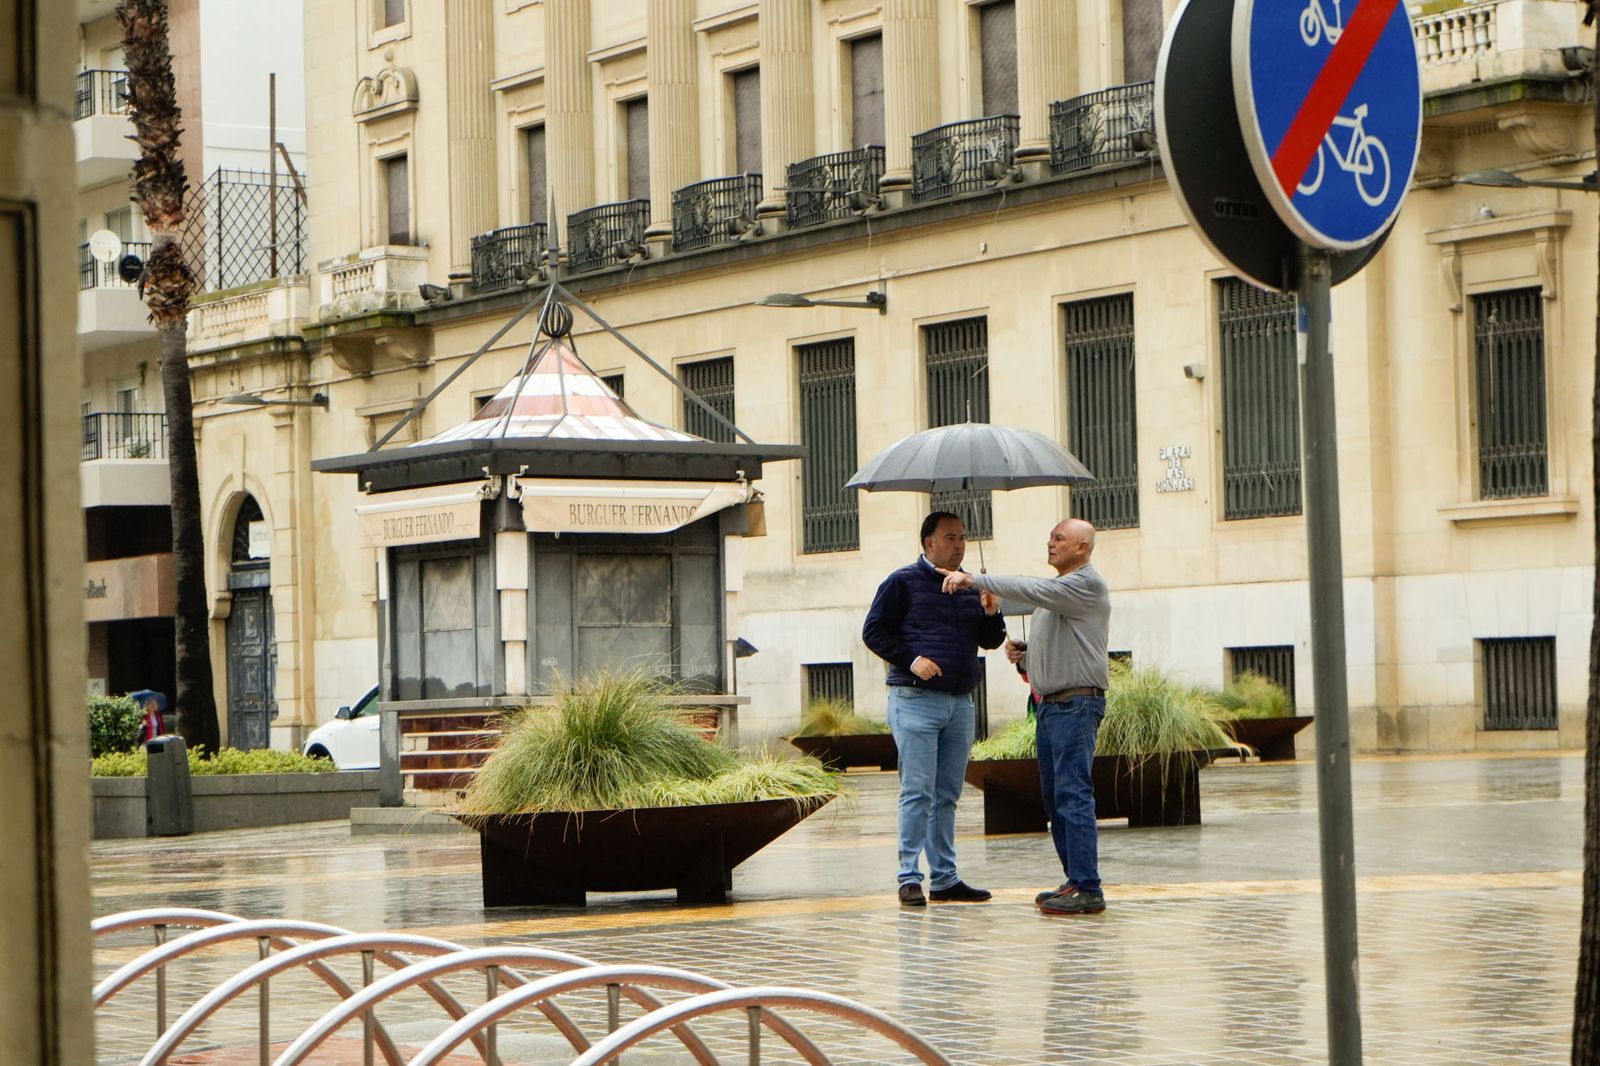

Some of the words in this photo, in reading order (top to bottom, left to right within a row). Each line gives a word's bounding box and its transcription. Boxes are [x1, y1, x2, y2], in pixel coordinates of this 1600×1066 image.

[1159, 446, 1191, 460] PLAZA
[1166, 468, 1184, 480] LAS
[1156, 479, 1194, 492] MONJAS
[569, 503, 627, 526] BURGUER
[384, 517, 414, 540] BURGUER
[416, 512, 454, 536] FERNANDO
